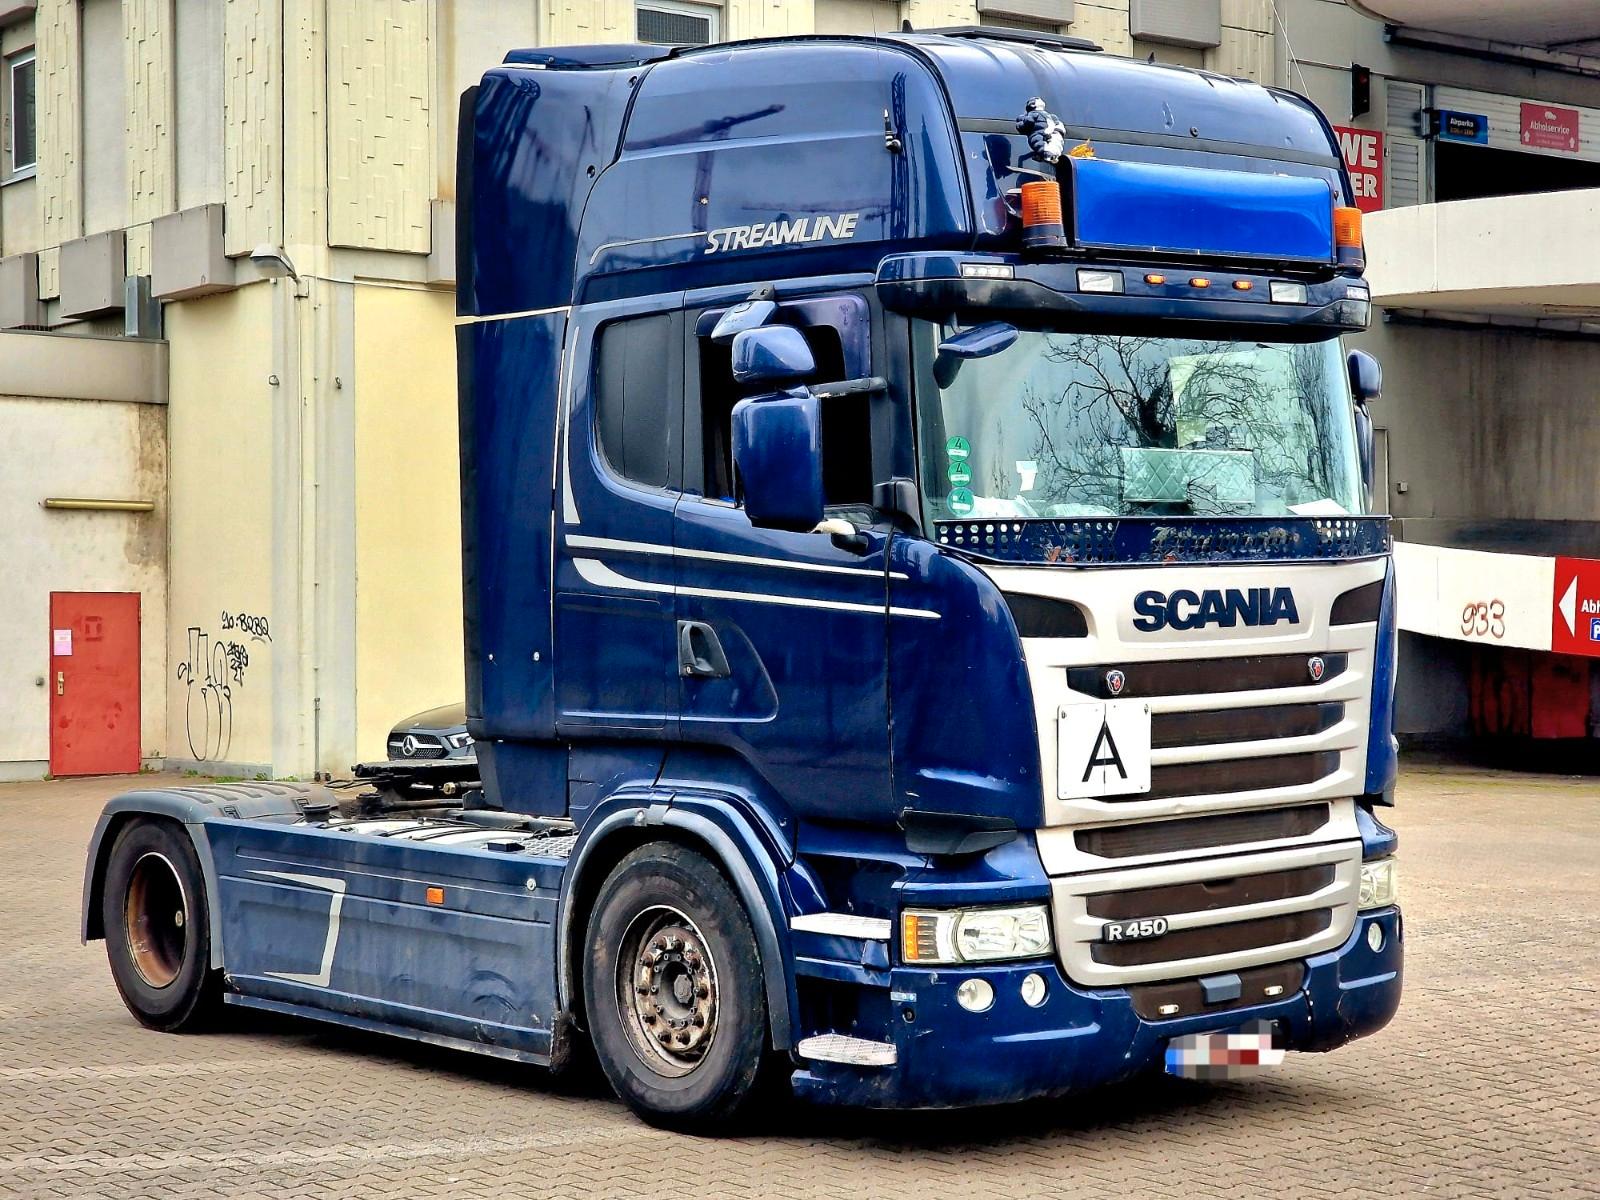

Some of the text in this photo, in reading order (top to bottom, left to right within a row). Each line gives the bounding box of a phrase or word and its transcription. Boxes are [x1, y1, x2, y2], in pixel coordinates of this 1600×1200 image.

[1530, 120, 1570, 135] Abholservice
[704, 213, 859, 255] STREAMLINE
[1132, 586, 1300, 633] SCANIA
[1461, 599, 1506, 639] 933
[1081, 719, 1128, 782] A
[1108, 918, 1167, 941] R 450
